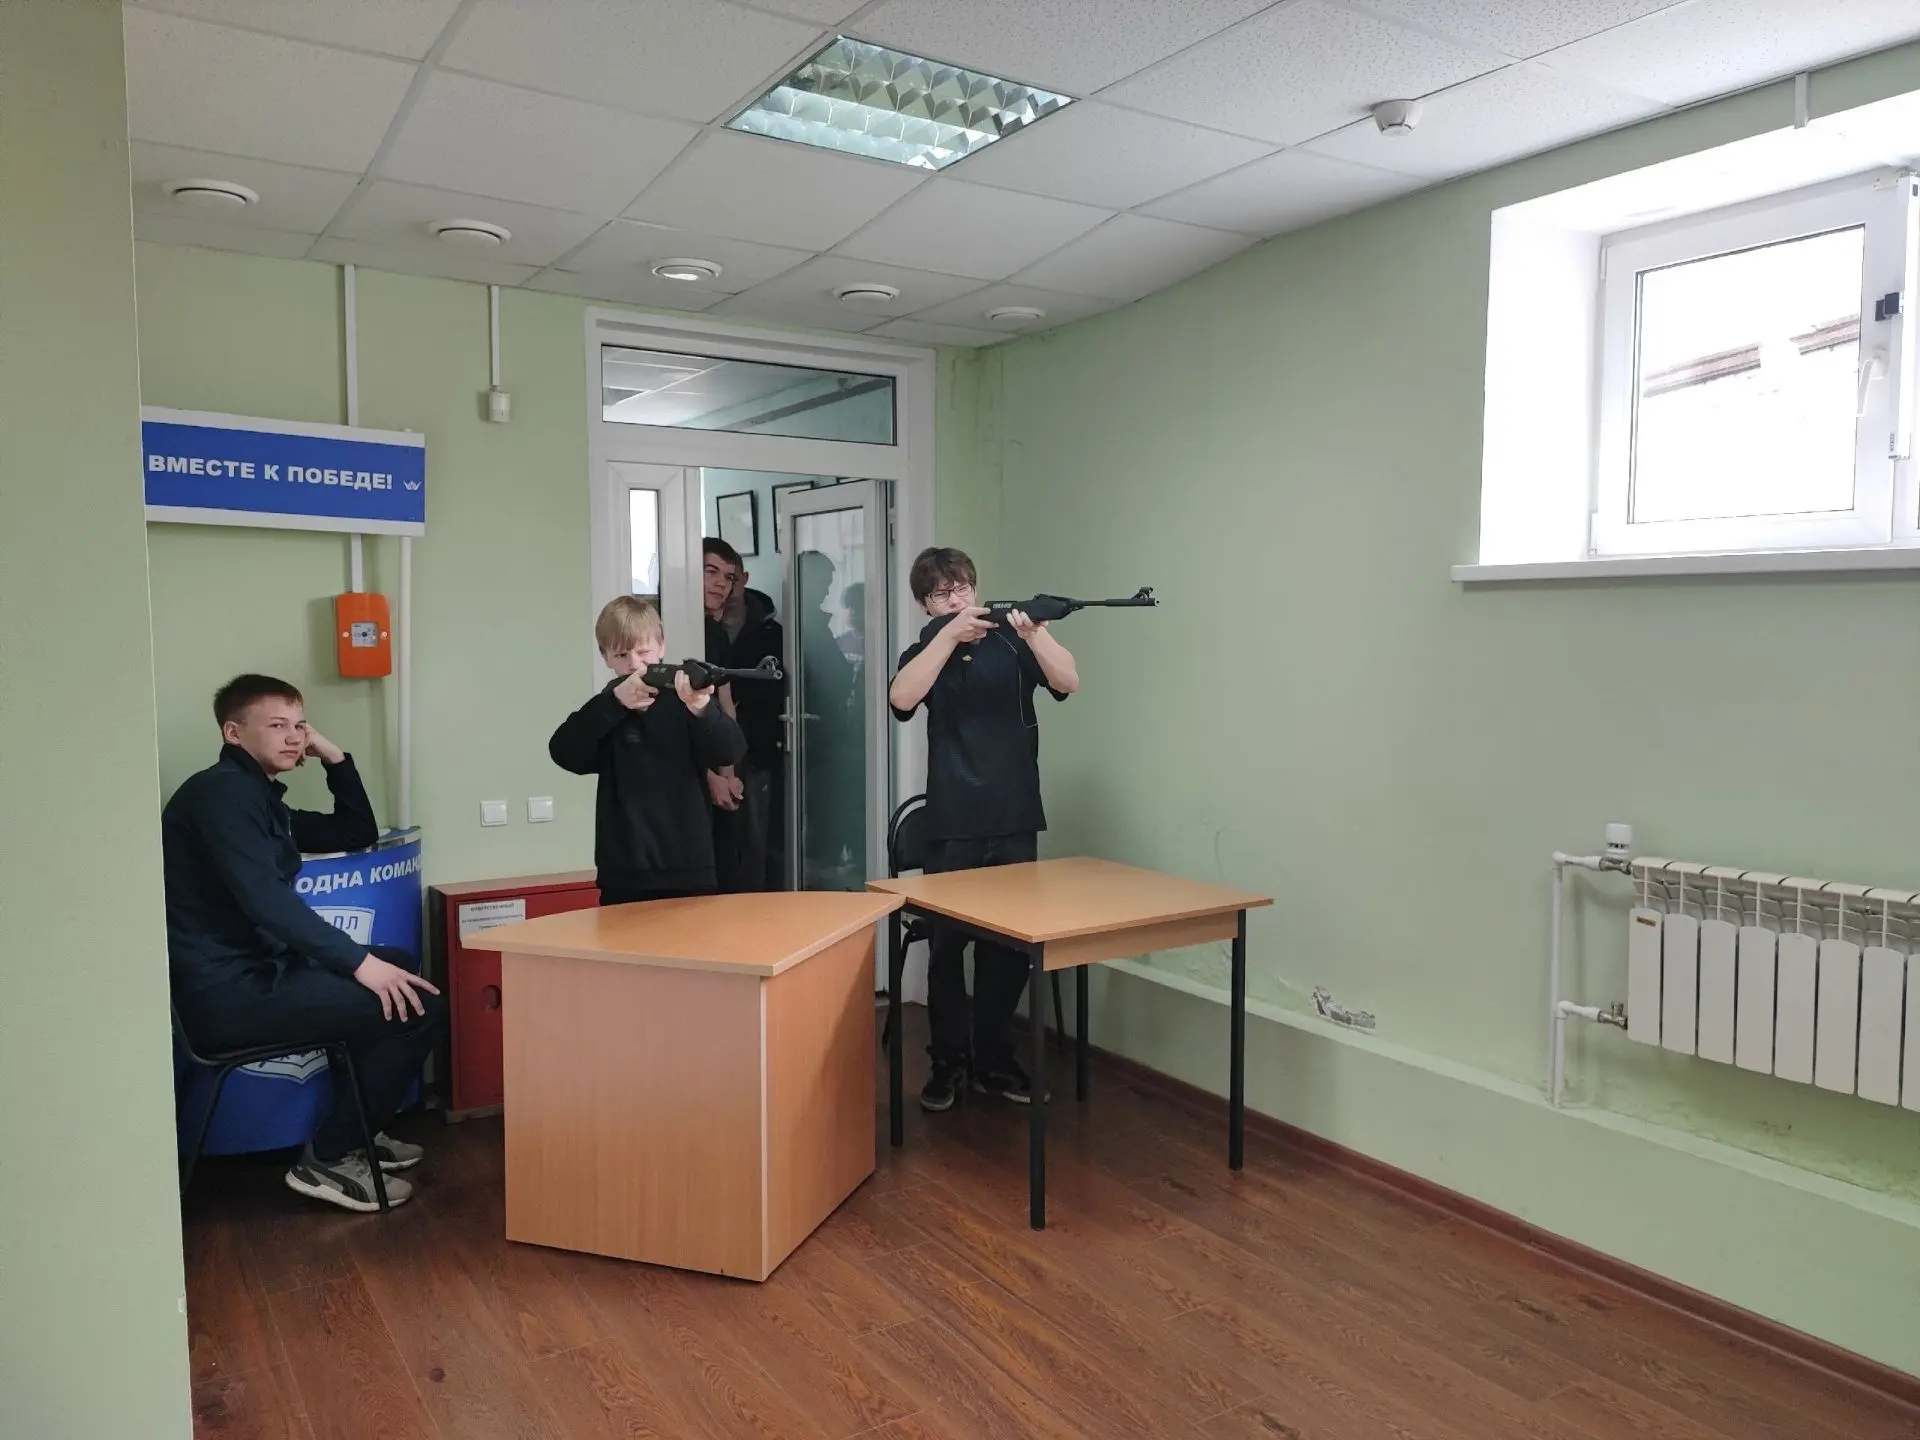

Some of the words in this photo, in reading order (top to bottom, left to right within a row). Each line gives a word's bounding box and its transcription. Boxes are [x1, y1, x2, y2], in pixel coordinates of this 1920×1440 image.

[148, 455, 255, 479] ВМЕСТЕ
[264, 465, 280, 482] К
[287, 466, 393, 490] ПОБЕДЕ!
[295, 870, 363, 896] ОДНА
